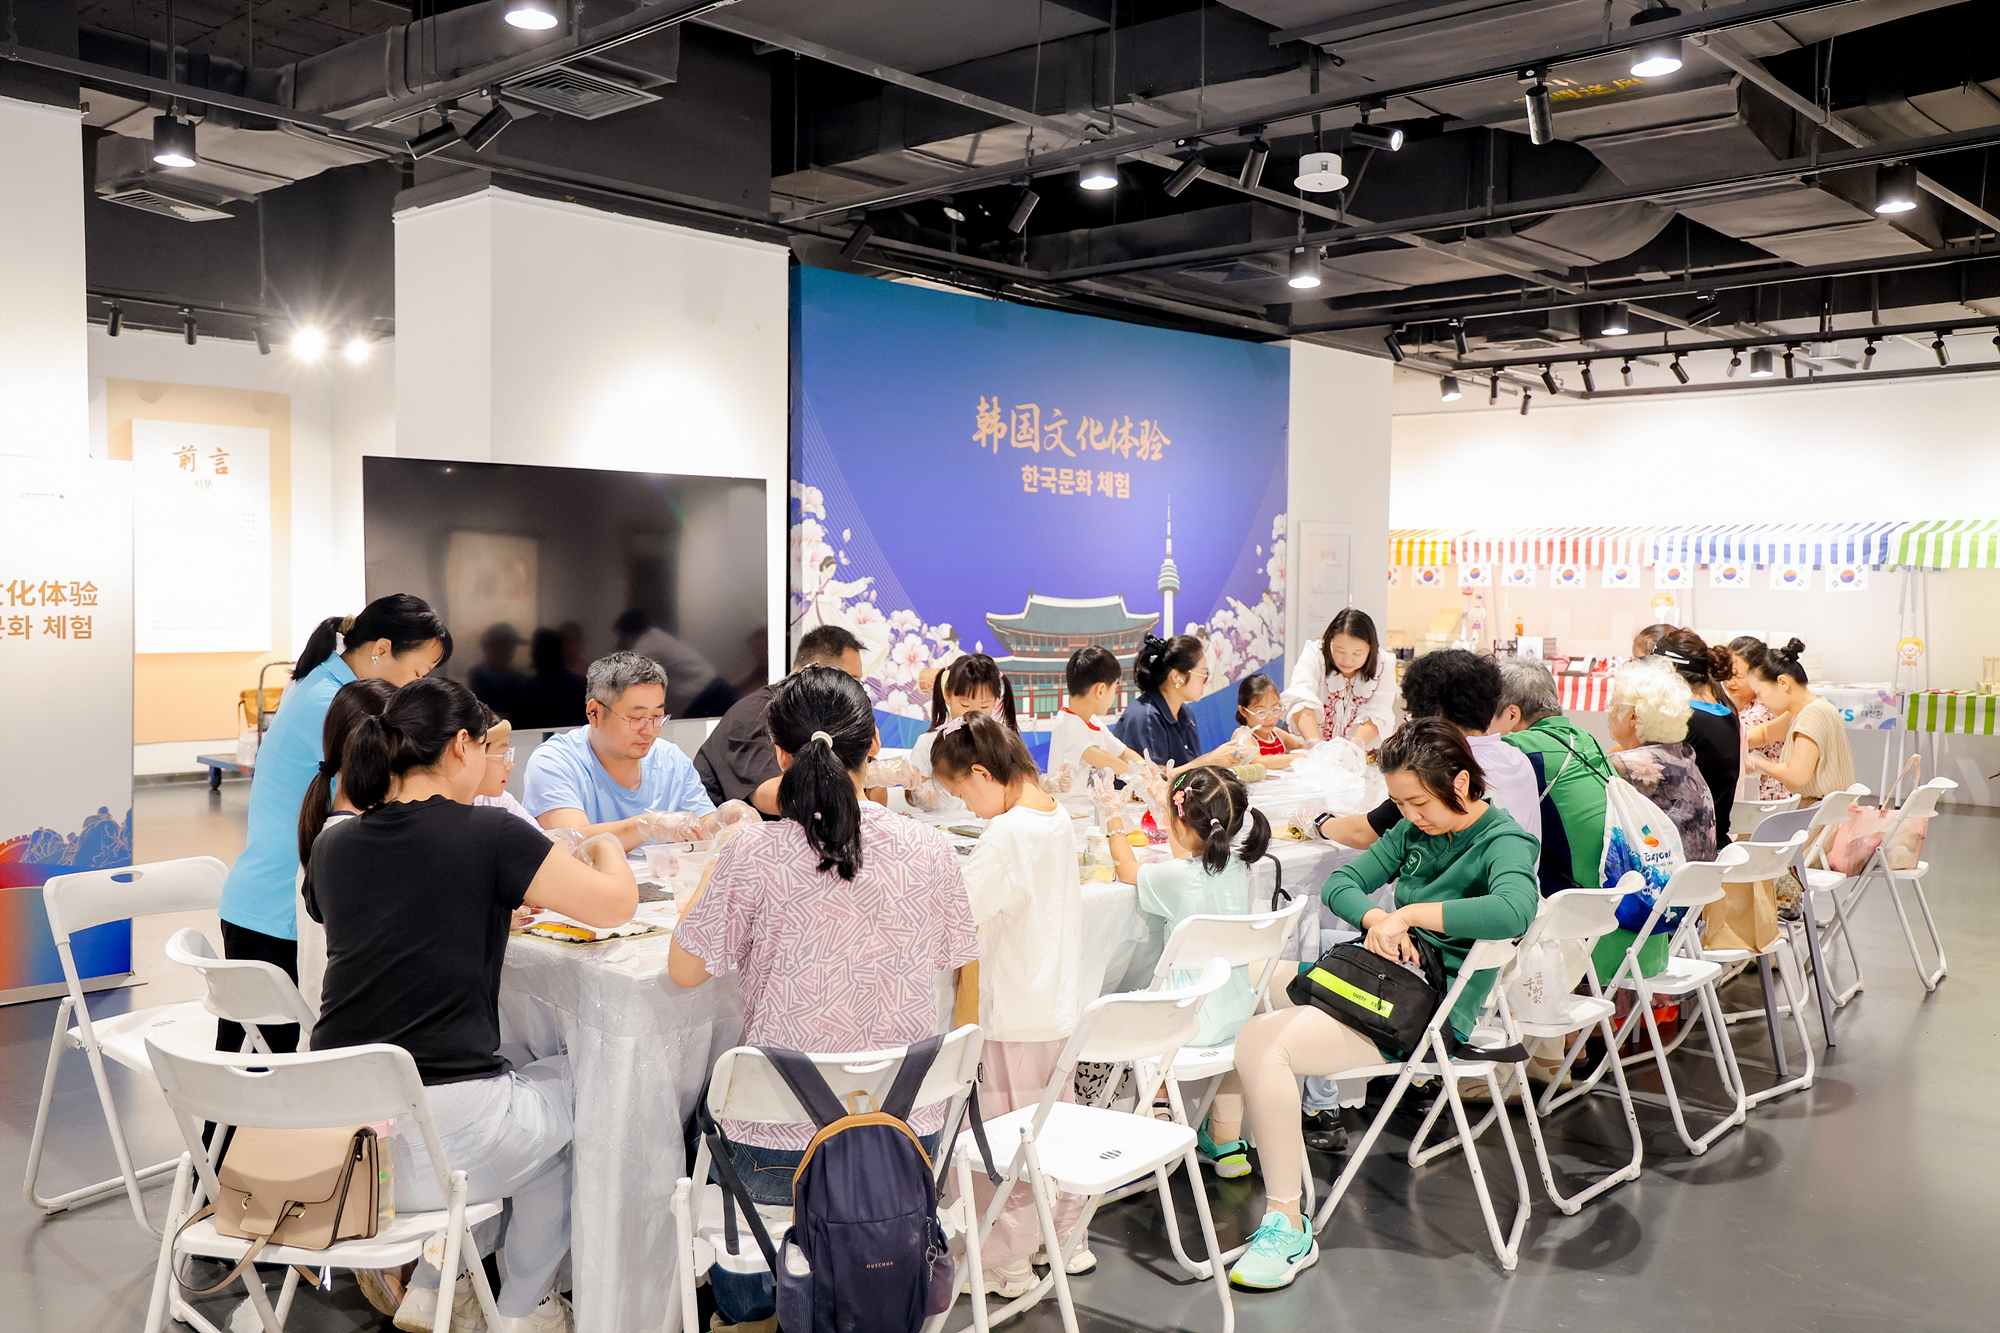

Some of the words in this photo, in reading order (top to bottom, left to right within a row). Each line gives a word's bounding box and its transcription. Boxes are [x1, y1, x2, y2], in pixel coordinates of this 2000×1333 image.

[972, 395, 1172, 461] 韩国文化体验
[172, 445, 230, 475] 前言
[1021, 464, 1093, 496] 한국문화
[1097, 471, 1130, 499] 체험
[0, 579, 98, 607] 化体验
[43, 615, 92, 640] 체험
